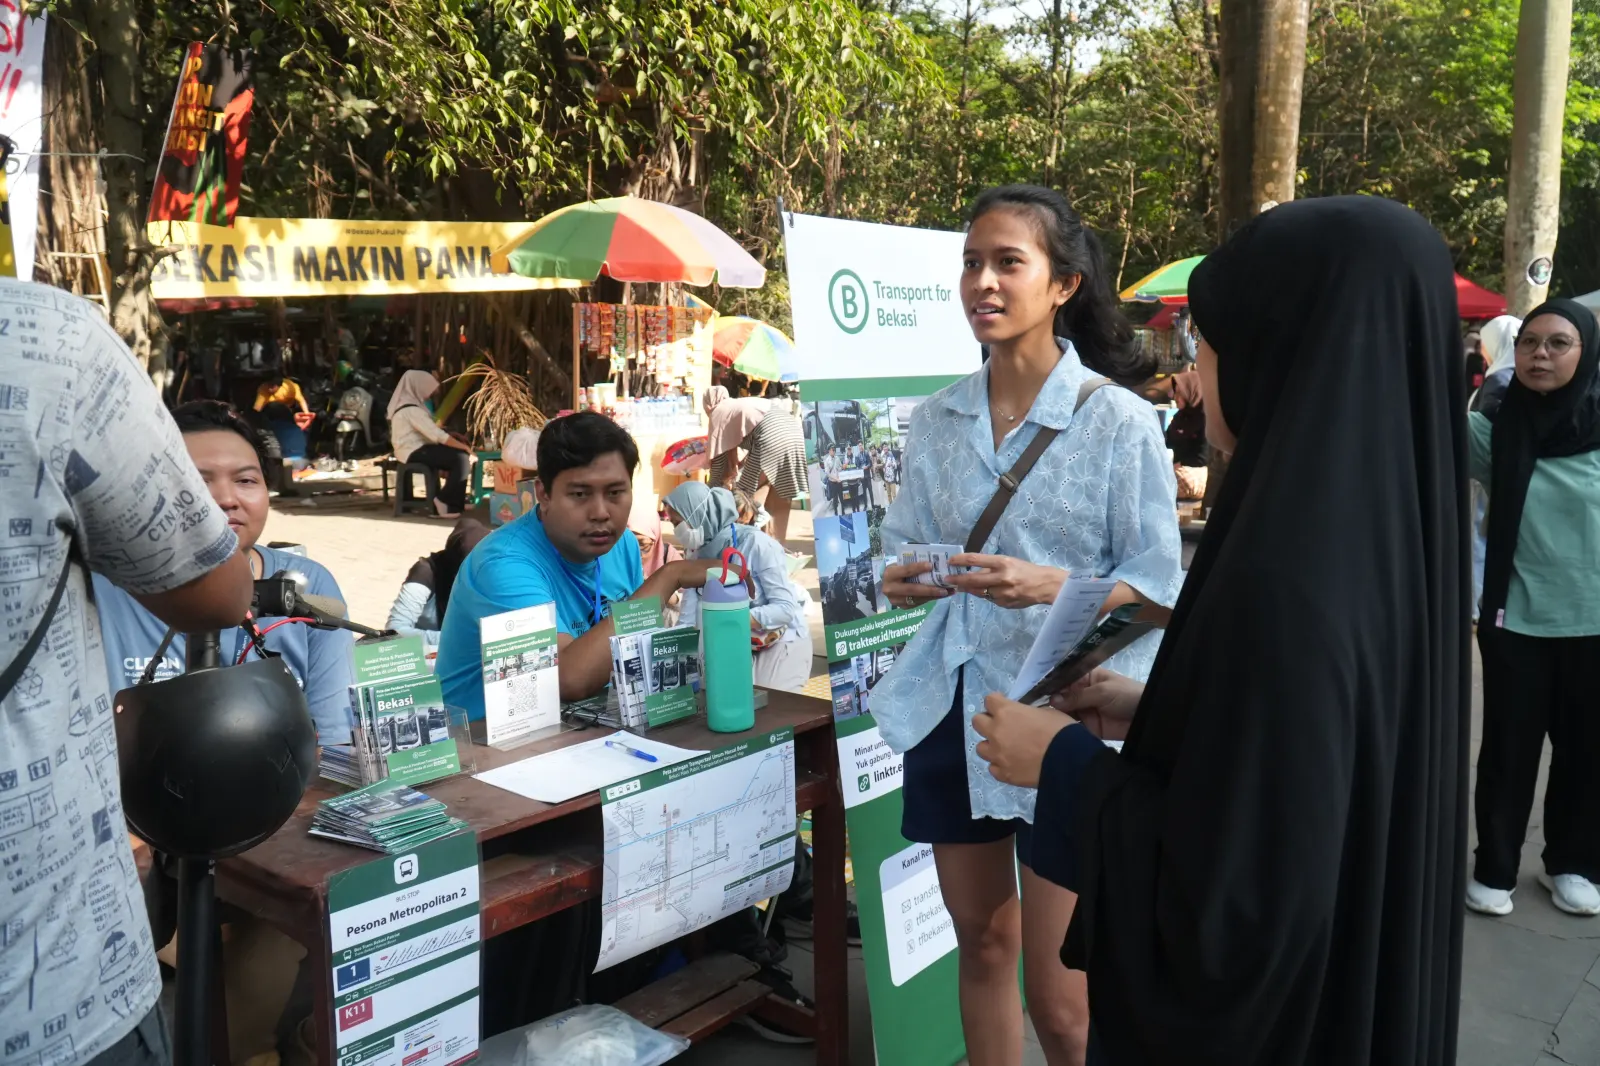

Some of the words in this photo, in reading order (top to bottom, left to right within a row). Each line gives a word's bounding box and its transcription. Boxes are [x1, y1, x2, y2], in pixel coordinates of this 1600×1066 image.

[293, 246, 405, 281] MAKIN
[415, 245, 508, 279] PANA
[872, 280, 934, 304] Transport
[935, 284, 952, 302] for
[876, 307, 918, 327] Bekasi
[834, 628, 860, 640] Dukung
[859, 622, 875, 634] selalu
[874, 616, 896, 630] kegiatan
[895, 612, 908, 623] kami
[653, 643, 679, 657] Bekasi
[377, 694, 414, 712] Bekasi
[854, 744, 873, 757] Minat
[856, 760, 868, 770] Yuk
[869, 750, 891, 765] gabung
[662, 768, 672, 776] Peta
[672, 763, 688, 774] Jaringan
[711, 752, 725, 760] Umum
[328, 793, 371, 807] Bekasi
[901, 851, 921, 870] Kanal
[920, 846, 934, 861] Res
[395, 894, 407, 903] BUS
[406, 889, 420, 899] STOP
[913, 883, 941, 906] transfo
[346, 916, 387, 938] Pesona
[389, 891, 459, 923] Metropolitan
[460, 887, 468, 897] 2
[915, 901, 947, 927] tfbekasi
[350, 964, 356, 977] 1
[345, 1002, 367, 1020] K11
